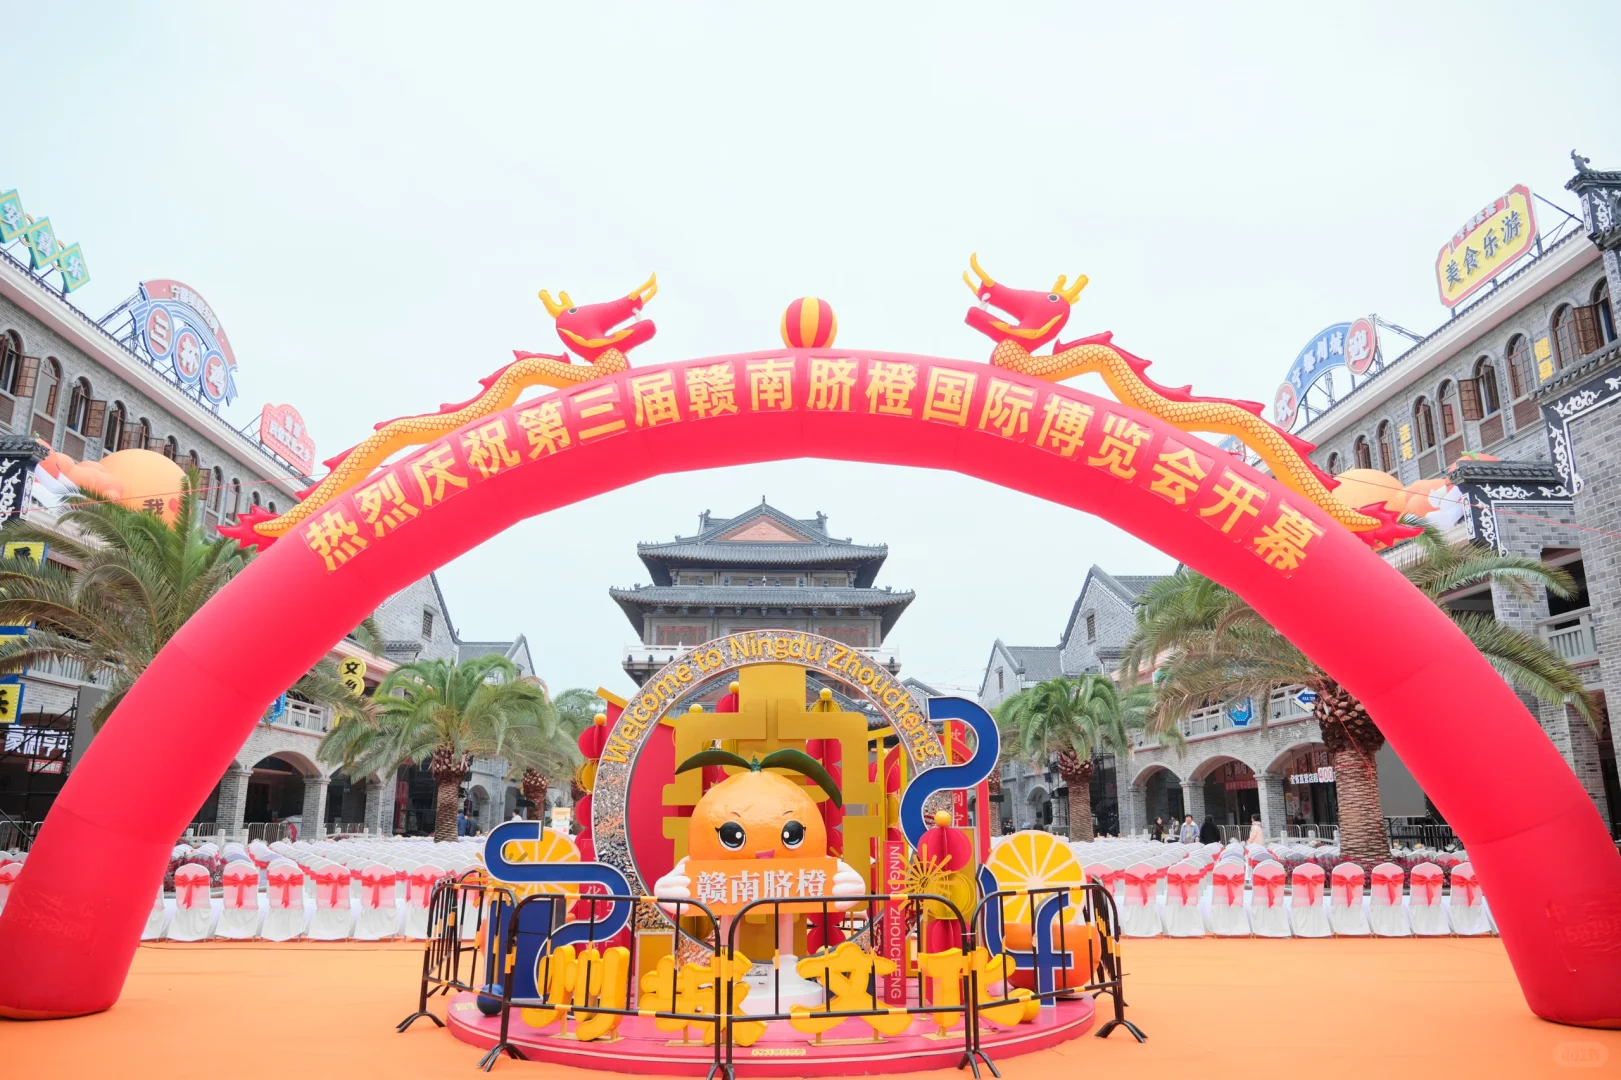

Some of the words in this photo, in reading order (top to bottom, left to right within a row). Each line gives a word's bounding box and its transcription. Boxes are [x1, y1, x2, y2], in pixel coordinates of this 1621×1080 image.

[1445, 210, 1521, 292] 美食乐游
[306, 356, 1324, 572] 热烈庆祝第三届赣南脐橙国际博览会开幕
[603, 664, 693, 763] Welcome
[694, 649, 722, 673] to
[729, 633, 822, 661] Ningdu
[827, 644, 943, 762] Zhoucheng
[696, 868, 827, 905] 赣南脐橙
